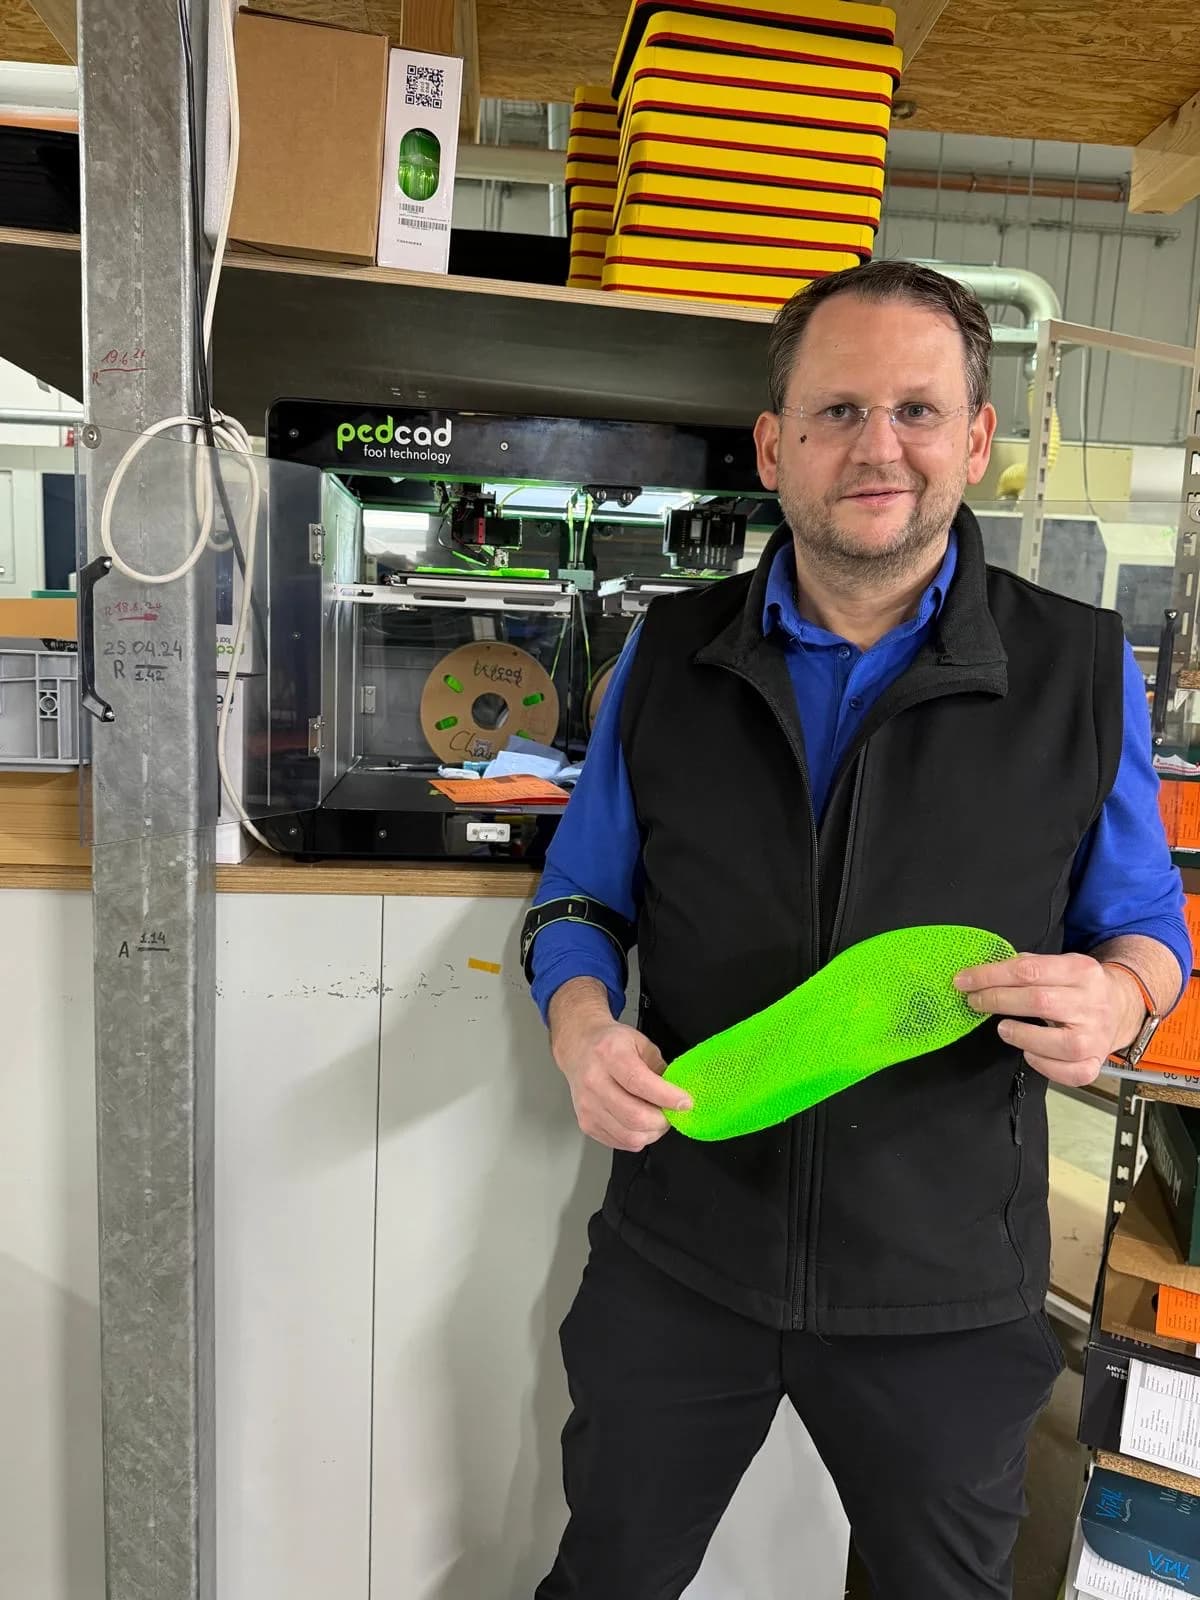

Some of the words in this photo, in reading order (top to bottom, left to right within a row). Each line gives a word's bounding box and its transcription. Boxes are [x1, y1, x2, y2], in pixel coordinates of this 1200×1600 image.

[363, 444, 387, 458] foot
[390, 447, 451, 465] technology
[113, 659, 126, 679] R
[118, 941, 129, 958] A
